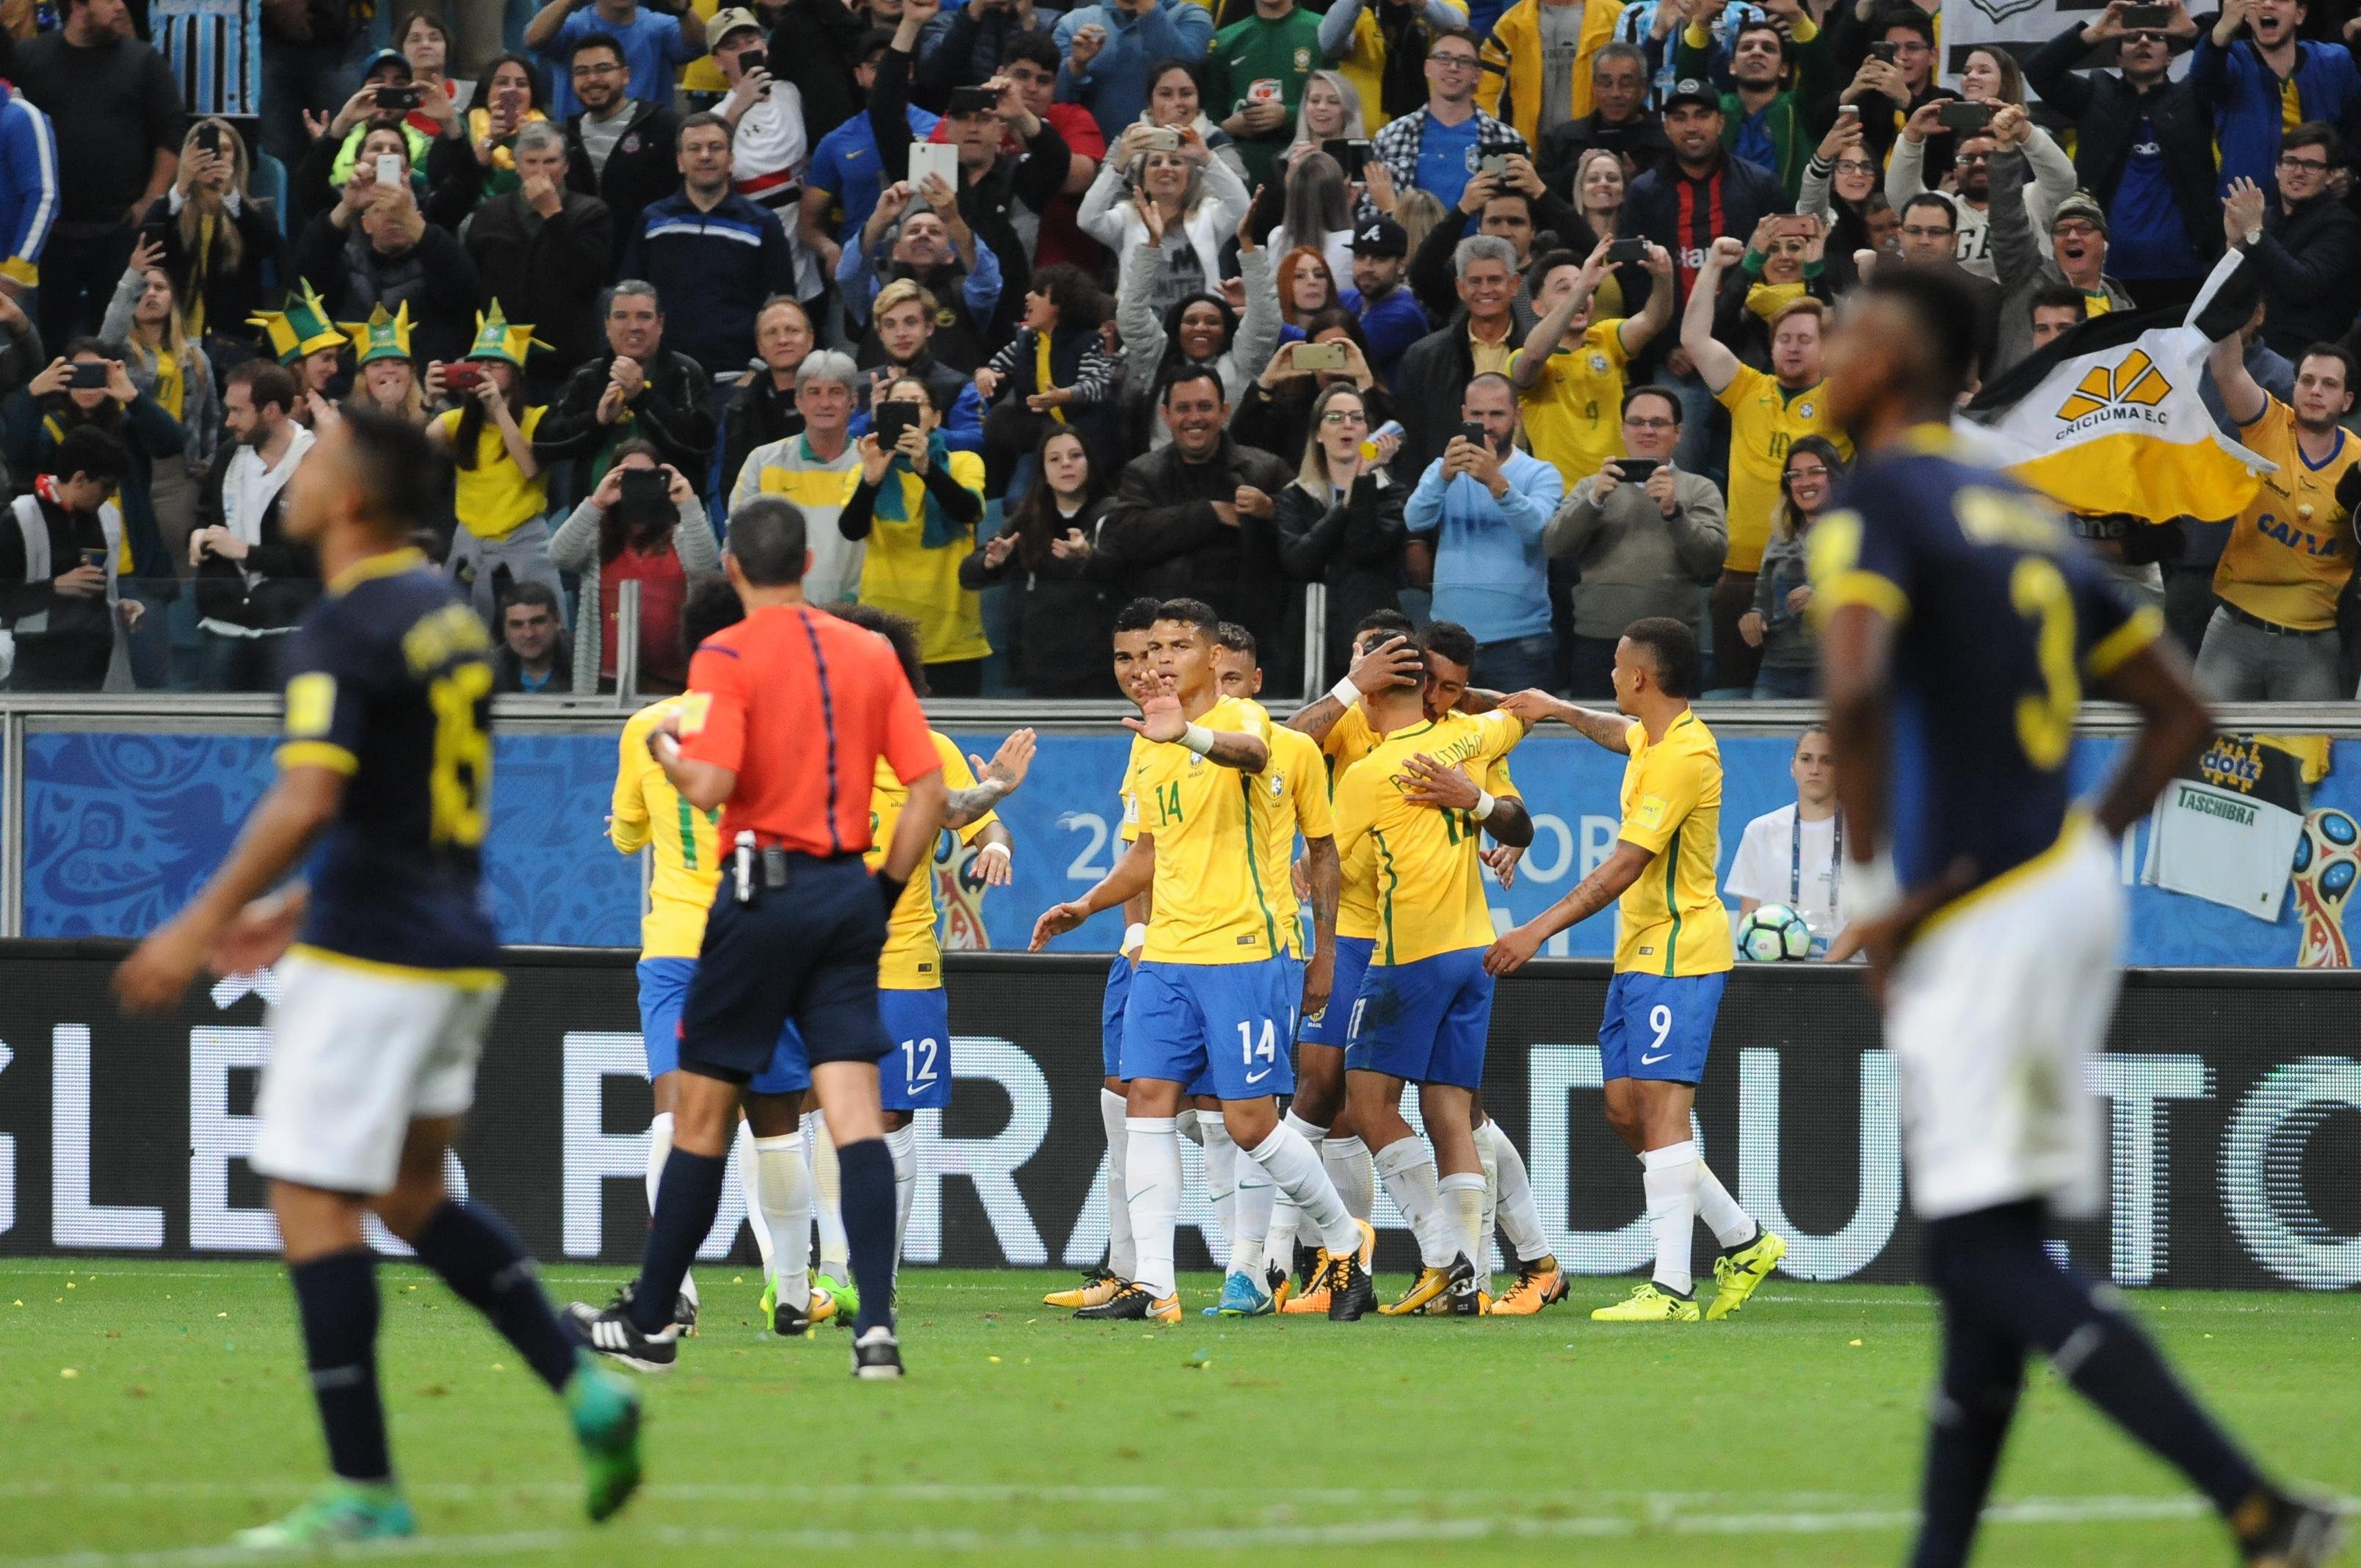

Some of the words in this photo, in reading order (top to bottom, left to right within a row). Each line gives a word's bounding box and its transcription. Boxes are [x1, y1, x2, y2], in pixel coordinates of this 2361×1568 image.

[2056, 407, 2139, 440] CRICIÚMA
[2257, 513, 2338, 556] CAIXA
[2203, 748, 2257, 780] dotz
[1155, 780, 1183, 827] 14
[2177, 785, 2260, 827] TASCHIBRA
[1237, 1018, 1276, 1065] 14
[1649, 1004, 1672, 1049] 9
[902, 1037, 938, 1082] 12
